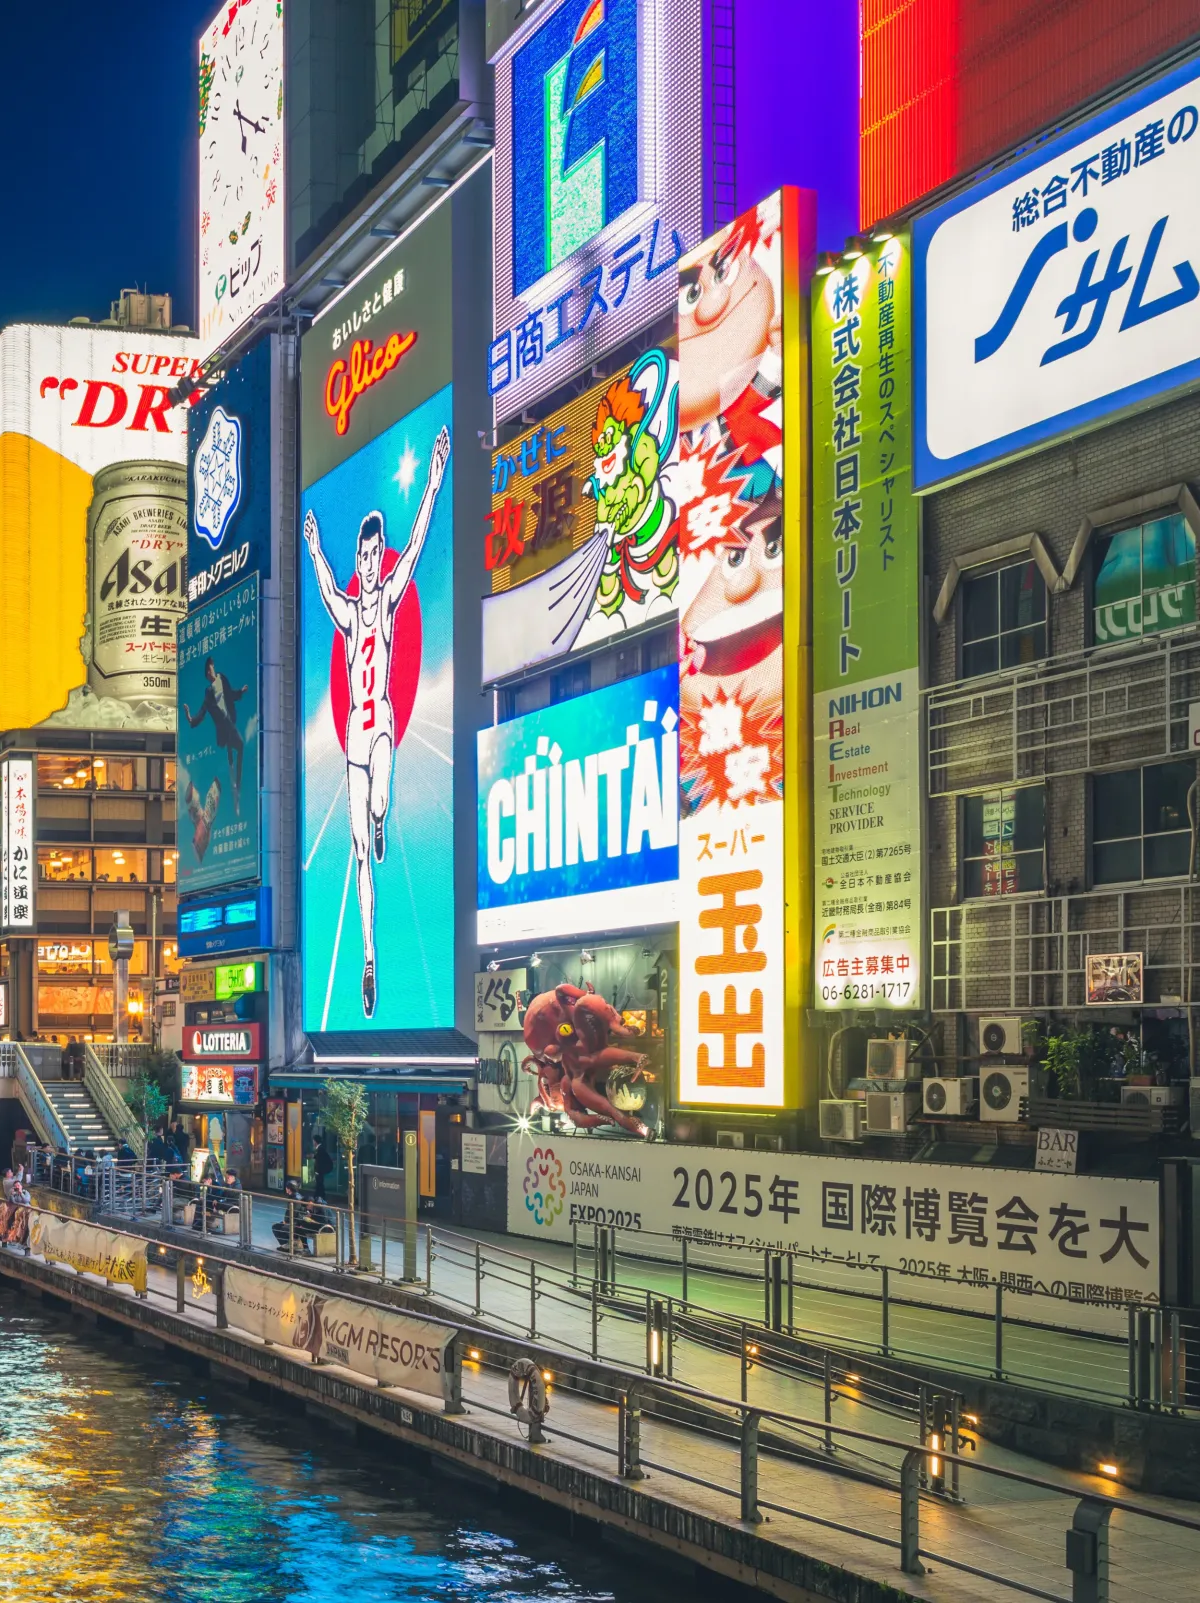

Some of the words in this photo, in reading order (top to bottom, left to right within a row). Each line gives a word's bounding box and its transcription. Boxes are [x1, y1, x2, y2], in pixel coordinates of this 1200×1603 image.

[1011, 105, 1199, 233] 総合不動産の
[332, 268, 405, 350] おいしさと健康
[487, 218, 682, 397] 日商エステム
[325, 331, 417, 436] Glico
[877, 251, 896, 571] 不動産再生のスペシャリスト
[491, 425, 567, 494] かぜに
[832, 273, 862, 675] 株式会社日本リート
[133, 508, 174, 521] BREWERIES
[188, 541, 250, 602] 雪印メグミルク
[140, 614, 173, 638] 生
[143, 676, 171, 689] 350ml
[360, 628, 377, 732] グリコ
[828, 682, 902, 718] NIHON
[828, 719, 861, 740] Real
[828, 740, 871, 762] Estate
[829, 761, 889, 783] Investment
[828, 784, 891, 803] Technology
[829, 802, 875, 820] SERVICE
[830, 815, 884, 835] PROVIDER
[696, 825, 765, 862] スーパー
[13, 846, 30, 920] かに道楽
[840, 871, 912, 890] 全日本不動産協会
[823, 953, 910, 978] 広告主募集中
[695, 869, 768, 1088] 玉出
[822, 982, 911, 1000] 06-6281-1717
[202, 1032, 246, 1051] LOTTERIA
[1037, 1130, 1076, 1153] BAR
[569, 1160, 641, 1183] OSAKA-KANSAI
[569, 1180, 599, 1199] JAPAN
[672, 1165, 800, 1224] 2025年
[821, 1181, 1150, 1270] 国際博覧会を大
[323, 1314, 363, 1351] MGM
[365, 1329, 441, 1374] RESORTS
